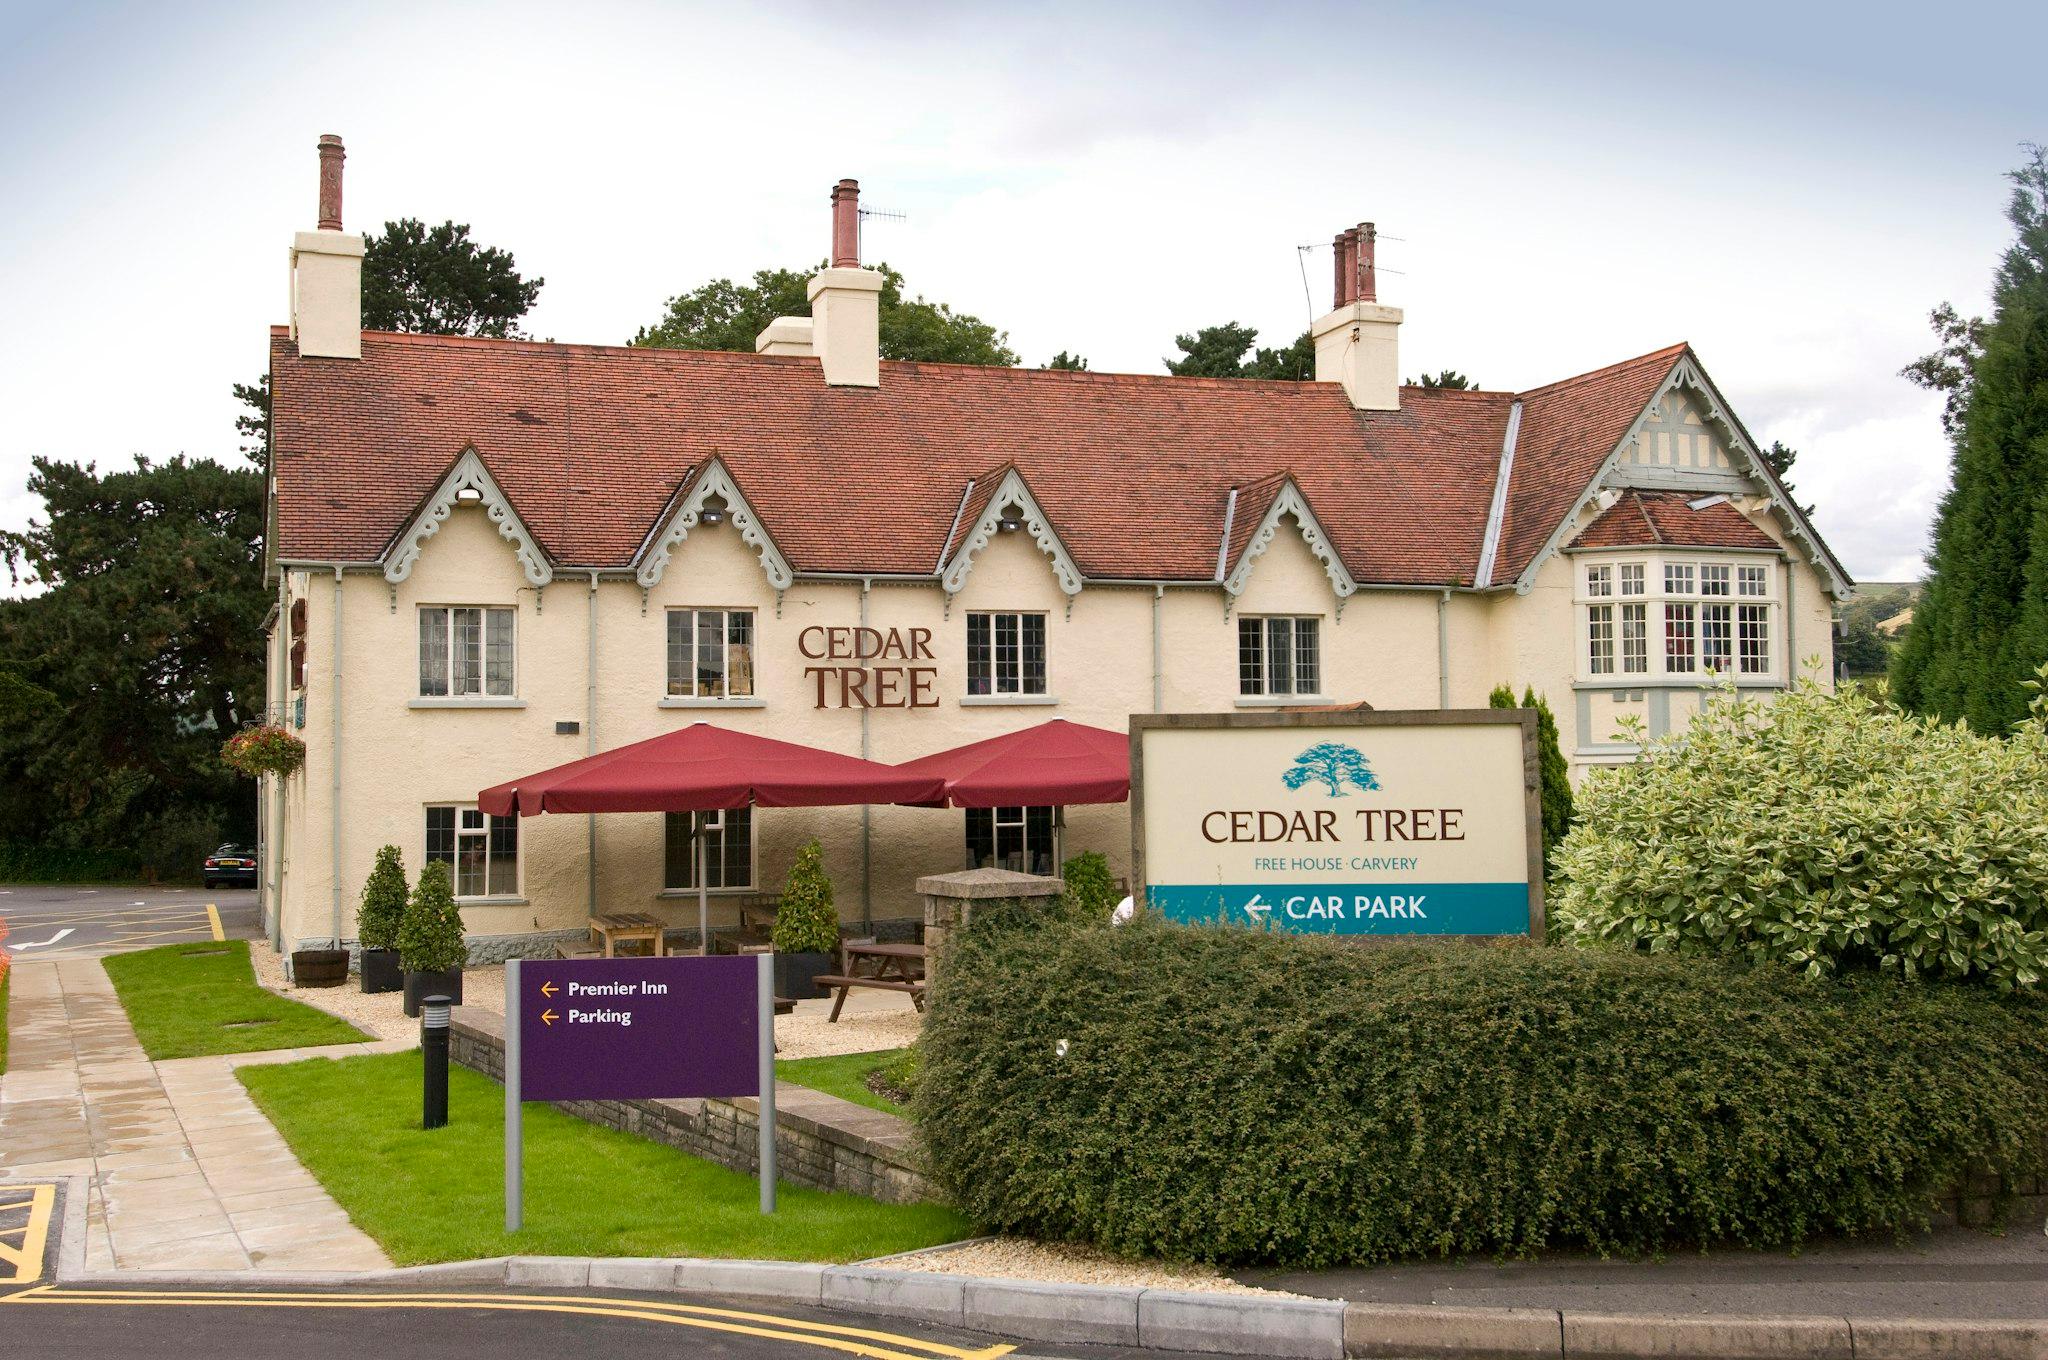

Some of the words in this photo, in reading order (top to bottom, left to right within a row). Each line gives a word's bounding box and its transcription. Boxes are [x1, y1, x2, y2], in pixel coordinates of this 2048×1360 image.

[798, 626, 936, 659] CEDAR
[804, 667, 940, 708] TREE
[1201, 810, 1341, 843] CEDAR
[1355, 809, 1465, 841] TREE
[1255, 857, 1287, 870] FREE
[1291, 857, 1343, 870] HOUSE
[1351, 857, 1418, 870] CARVERY
[1286, 896, 1346, 920] CAR
[1355, 895, 1427, 919] PARK
[568, 981, 637, 996] Premier
[641, 981, 668, 995] Inn
[568, 1009, 632, 1026] Parking
